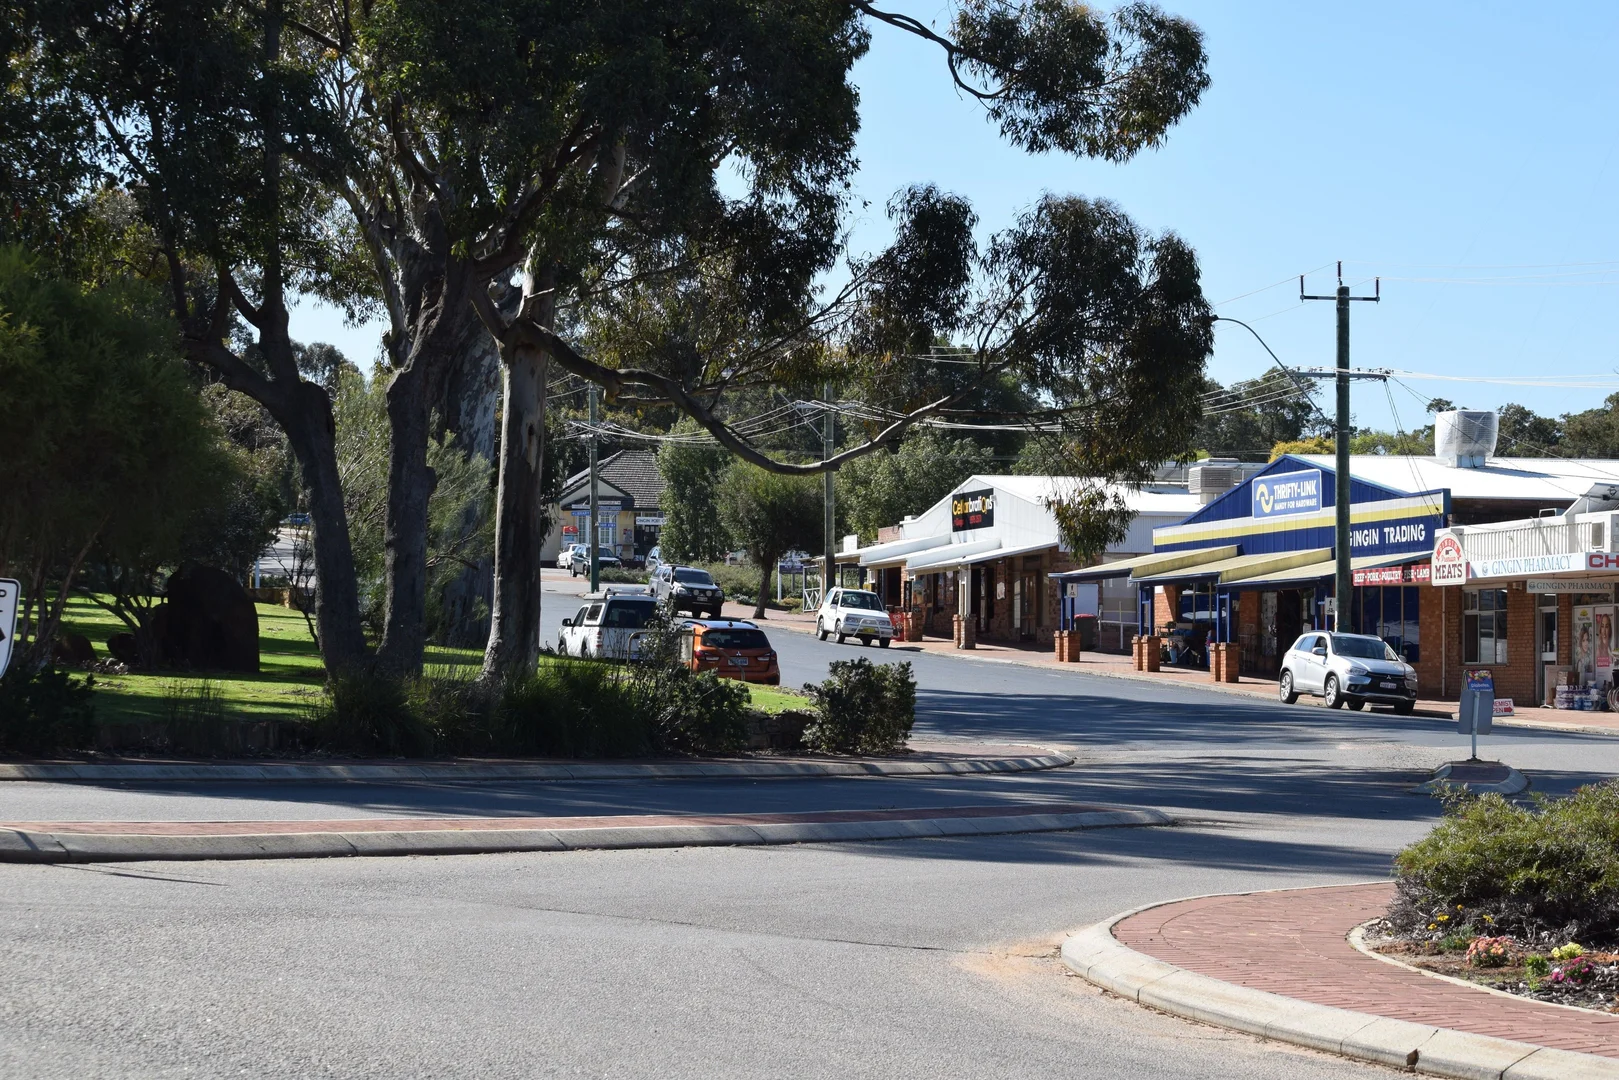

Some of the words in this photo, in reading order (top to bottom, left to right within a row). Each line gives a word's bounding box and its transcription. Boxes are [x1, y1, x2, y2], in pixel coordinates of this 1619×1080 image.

[1273, 480, 1317, 500] THRIFTY-LINK
[1287, 501, 1295, 509] FOR
[1296, 498, 1317, 508] HARDWARE
[1383, 524, 1426, 544] TRADING
[1435, 563, 1463, 580] MEATS
[1492, 559, 1523, 575] GINGIN
[1524, 555, 1572, 573] PHARMACY
[1354, 573, 1365, 582] BEEF
[1367, 572, 1380, 582] PORK
[1381, 570, 1401, 581] POULTRY
[1417, 568, 1430, 578] LAMB
[1536, 582, 1567, 590] GINGIN
[1568, 582, 1613, 590] PHARMACY
